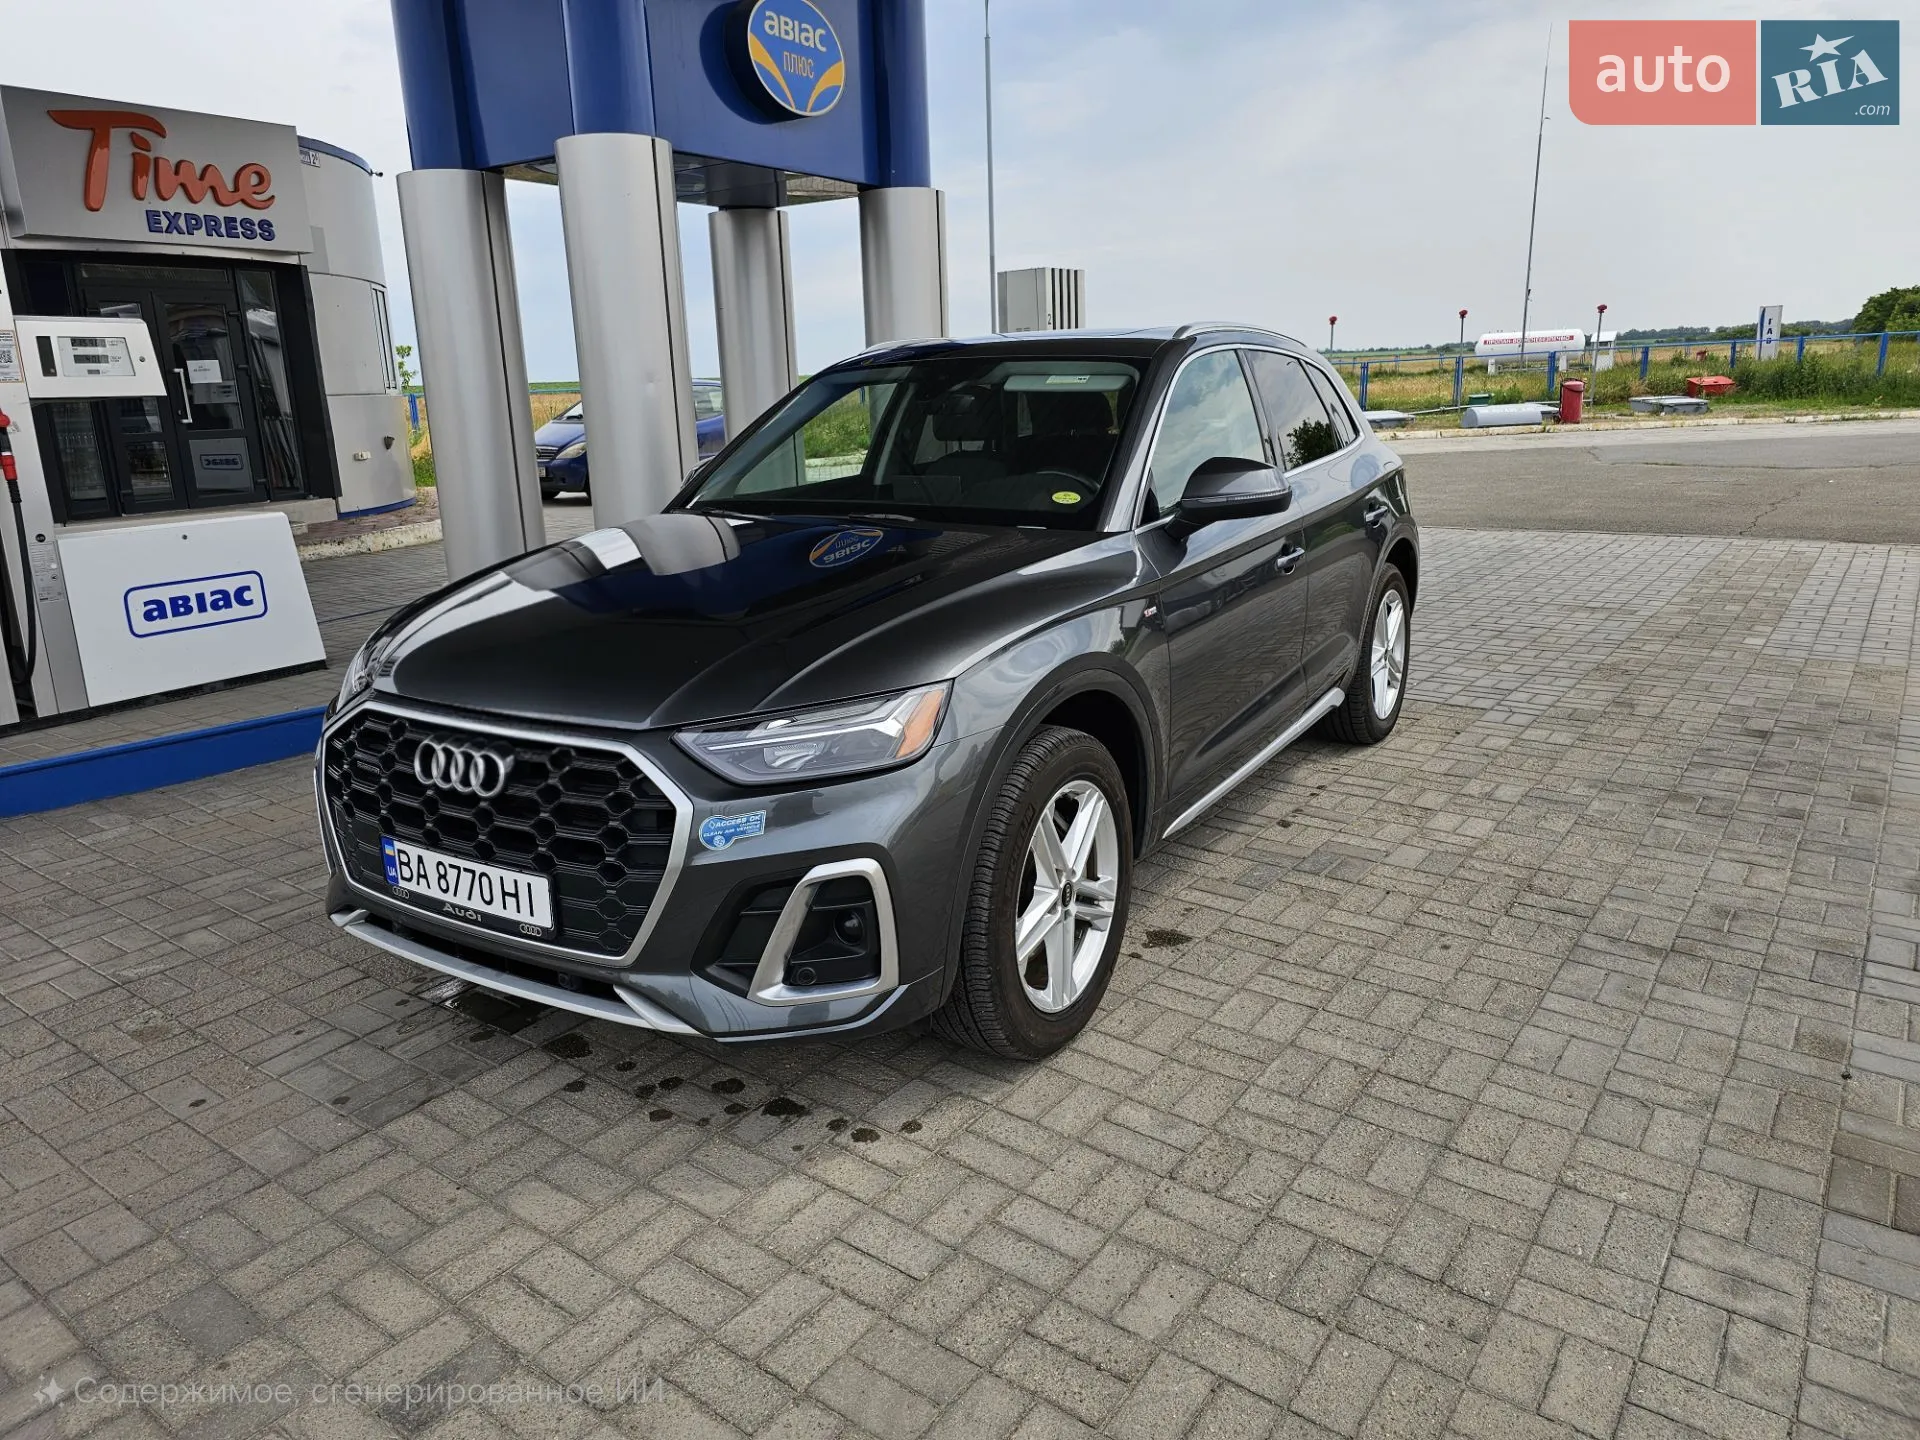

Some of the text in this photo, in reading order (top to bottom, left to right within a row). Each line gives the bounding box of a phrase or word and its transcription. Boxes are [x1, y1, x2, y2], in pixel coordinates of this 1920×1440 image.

[783, 51, 814, 79] ПЛЮС
[47, 109, 276, 212] Time
[145, 208, 276, 242] EXPRESS
[1047, 313, 1052, 325] 2
[387, 865, 397, 878] UA
[436, 861, 494, 906] 8770
[443, 902, 482, 922] Audi
